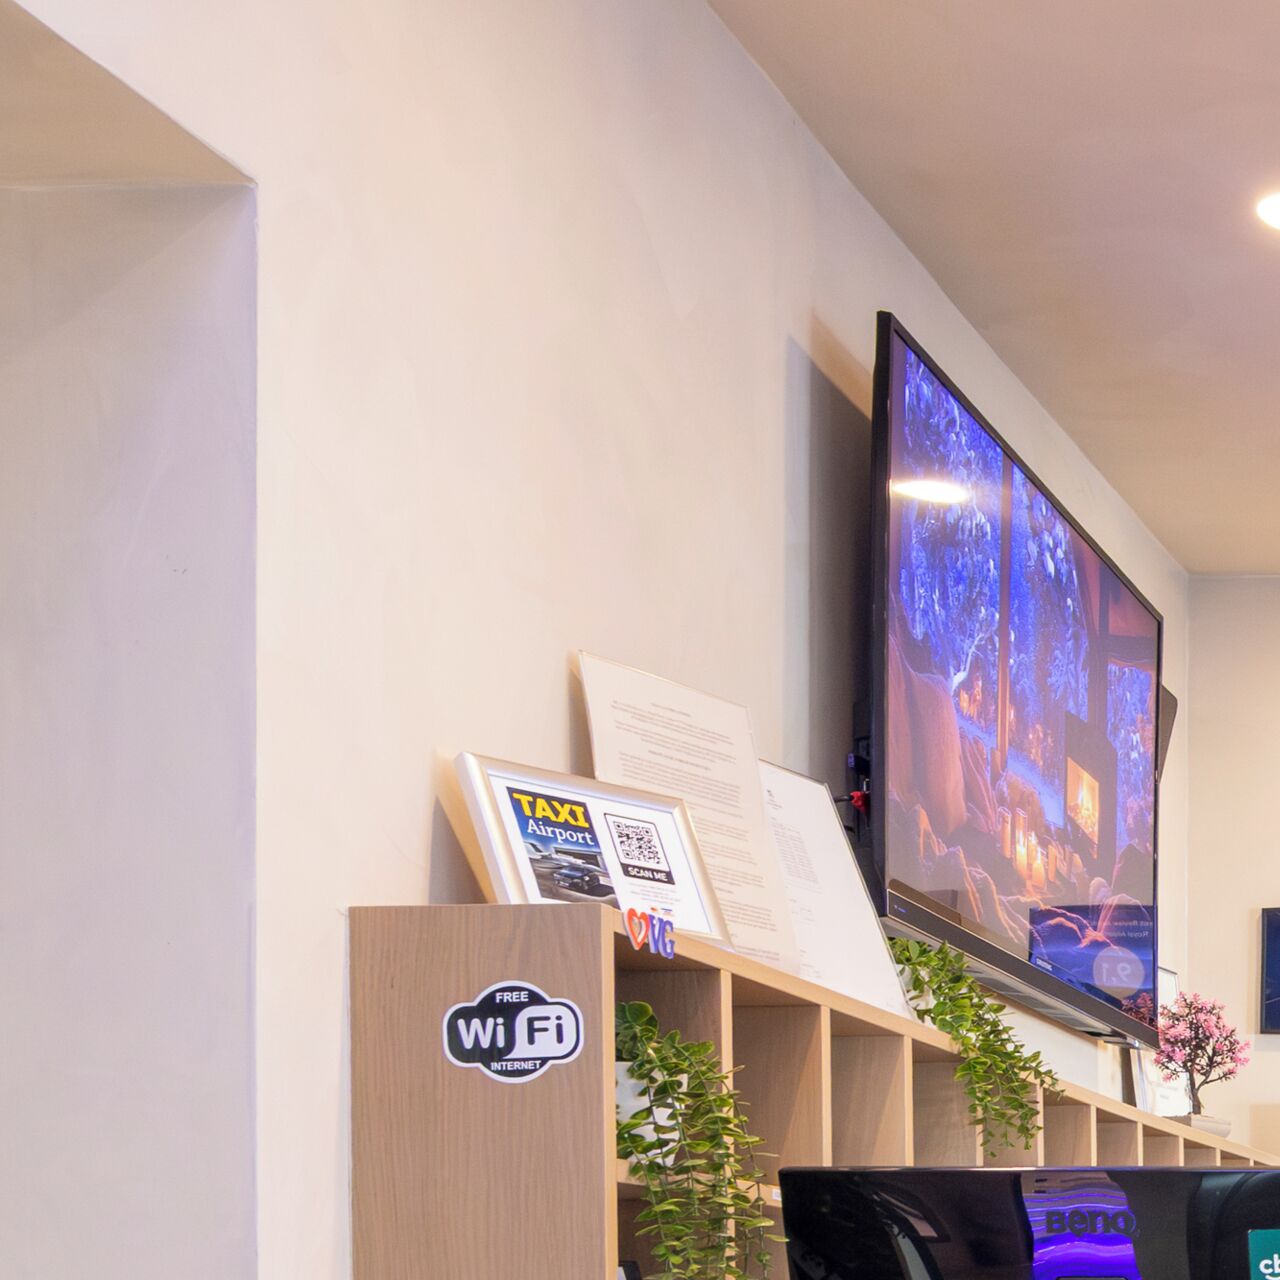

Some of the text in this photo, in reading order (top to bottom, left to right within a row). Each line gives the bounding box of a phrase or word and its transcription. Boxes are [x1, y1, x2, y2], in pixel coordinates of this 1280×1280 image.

[512, 793, 589, 828] TAXI
[527, 819, 595, 845] Airport
[628, 867, 668, 881] SCAN ME
[495, 991, 529, 1003] FREE
[490, 1060, 542, 1071] INTERNET
